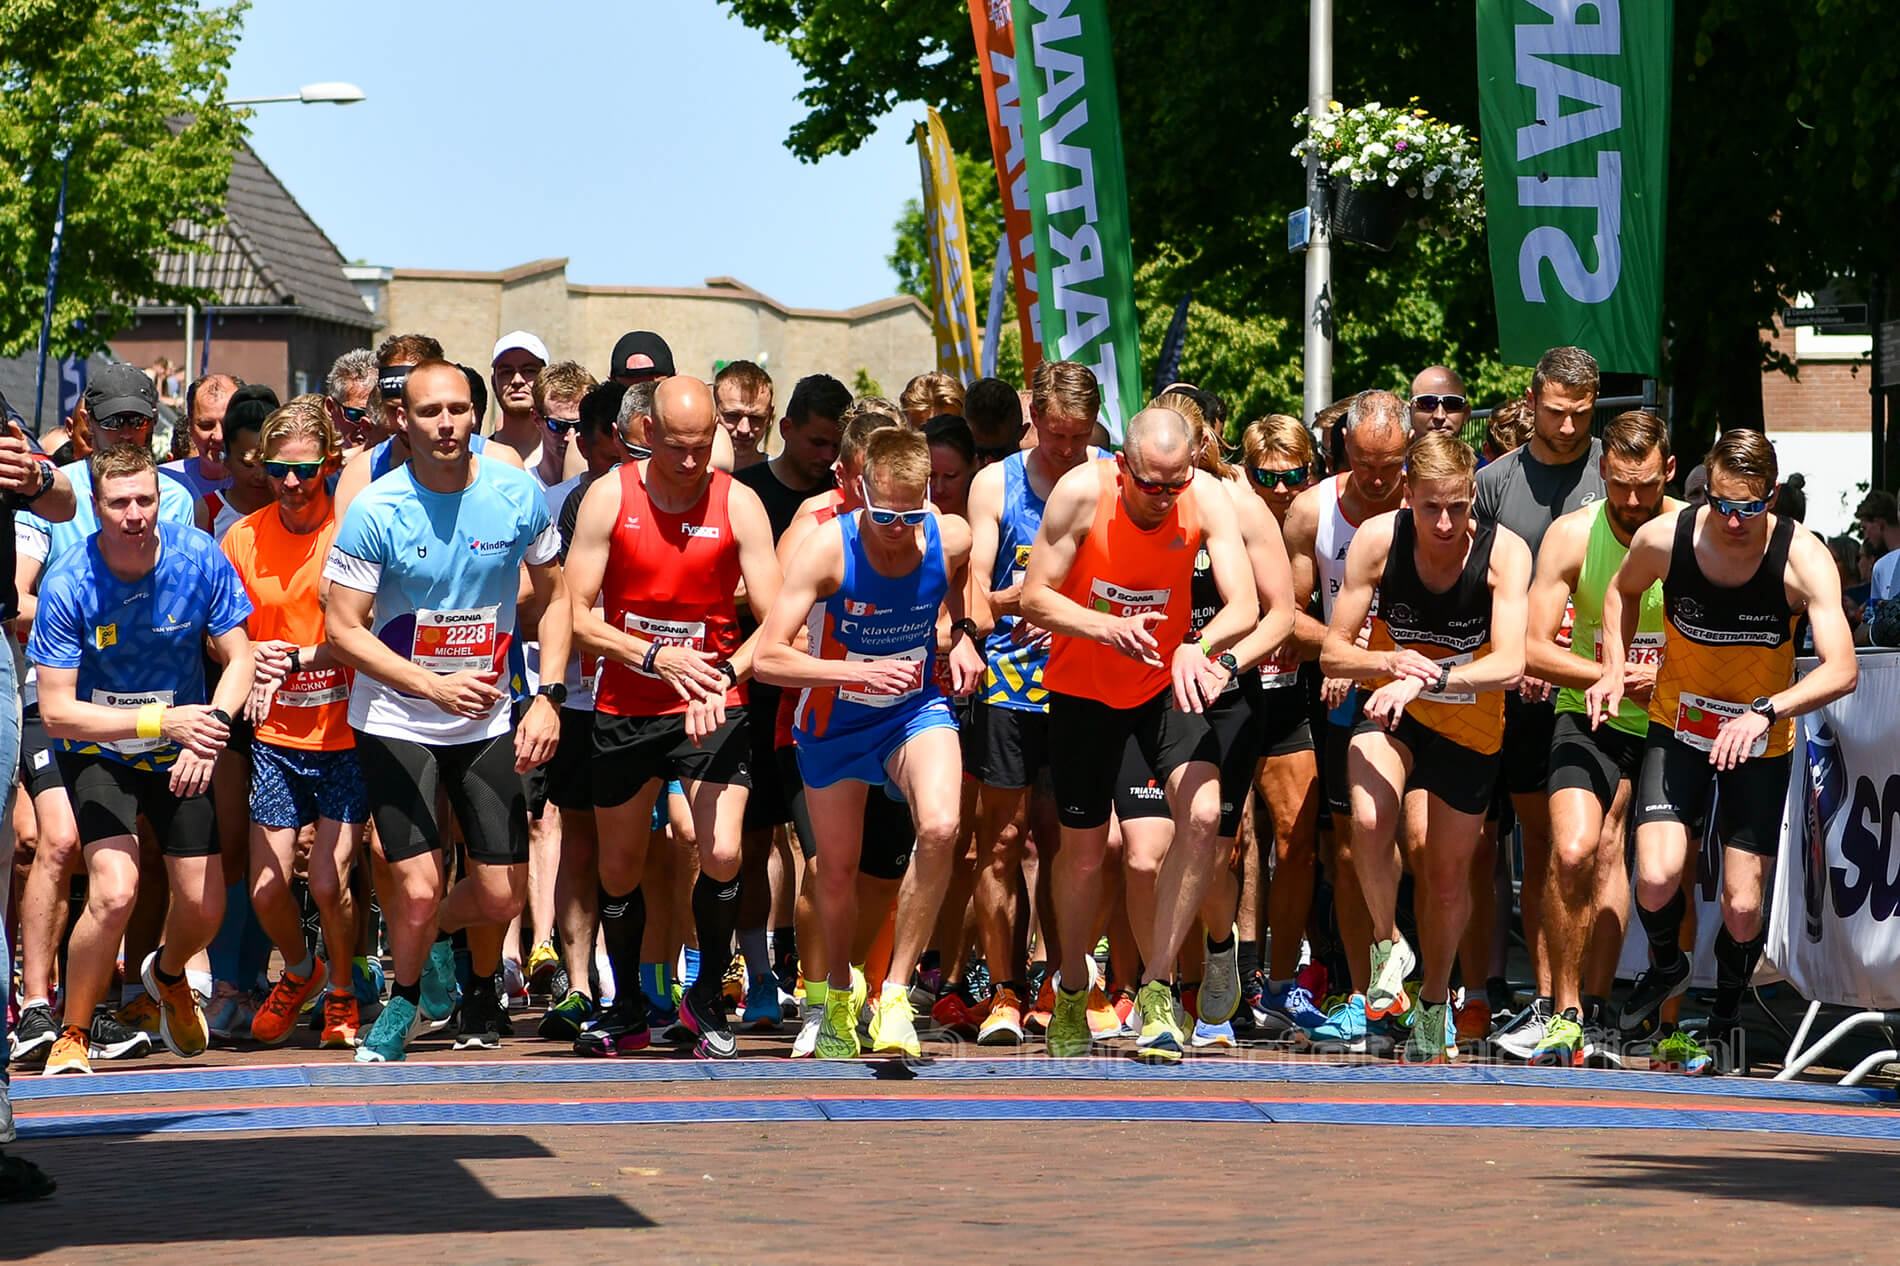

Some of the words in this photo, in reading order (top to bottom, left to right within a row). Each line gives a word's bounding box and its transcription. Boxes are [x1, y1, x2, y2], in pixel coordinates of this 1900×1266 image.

[1117, 592, 1154, 602] SCANIA
[445, 614, 482, 623] SCANIA
[1739, 614, 1769, 622] CRAFT
[650, 624, 688, 634] SCANIA
[446, 625, 487, 646] 2228
[434, 647, 474, 656] MICHEL
[290, 680, 328, 692] JACKNY
[118, 697, 157, 705] SCANIA
[1706, 702, 1745, 714] SCANIA
[1645, 803, 1673, 812] CRAFT
